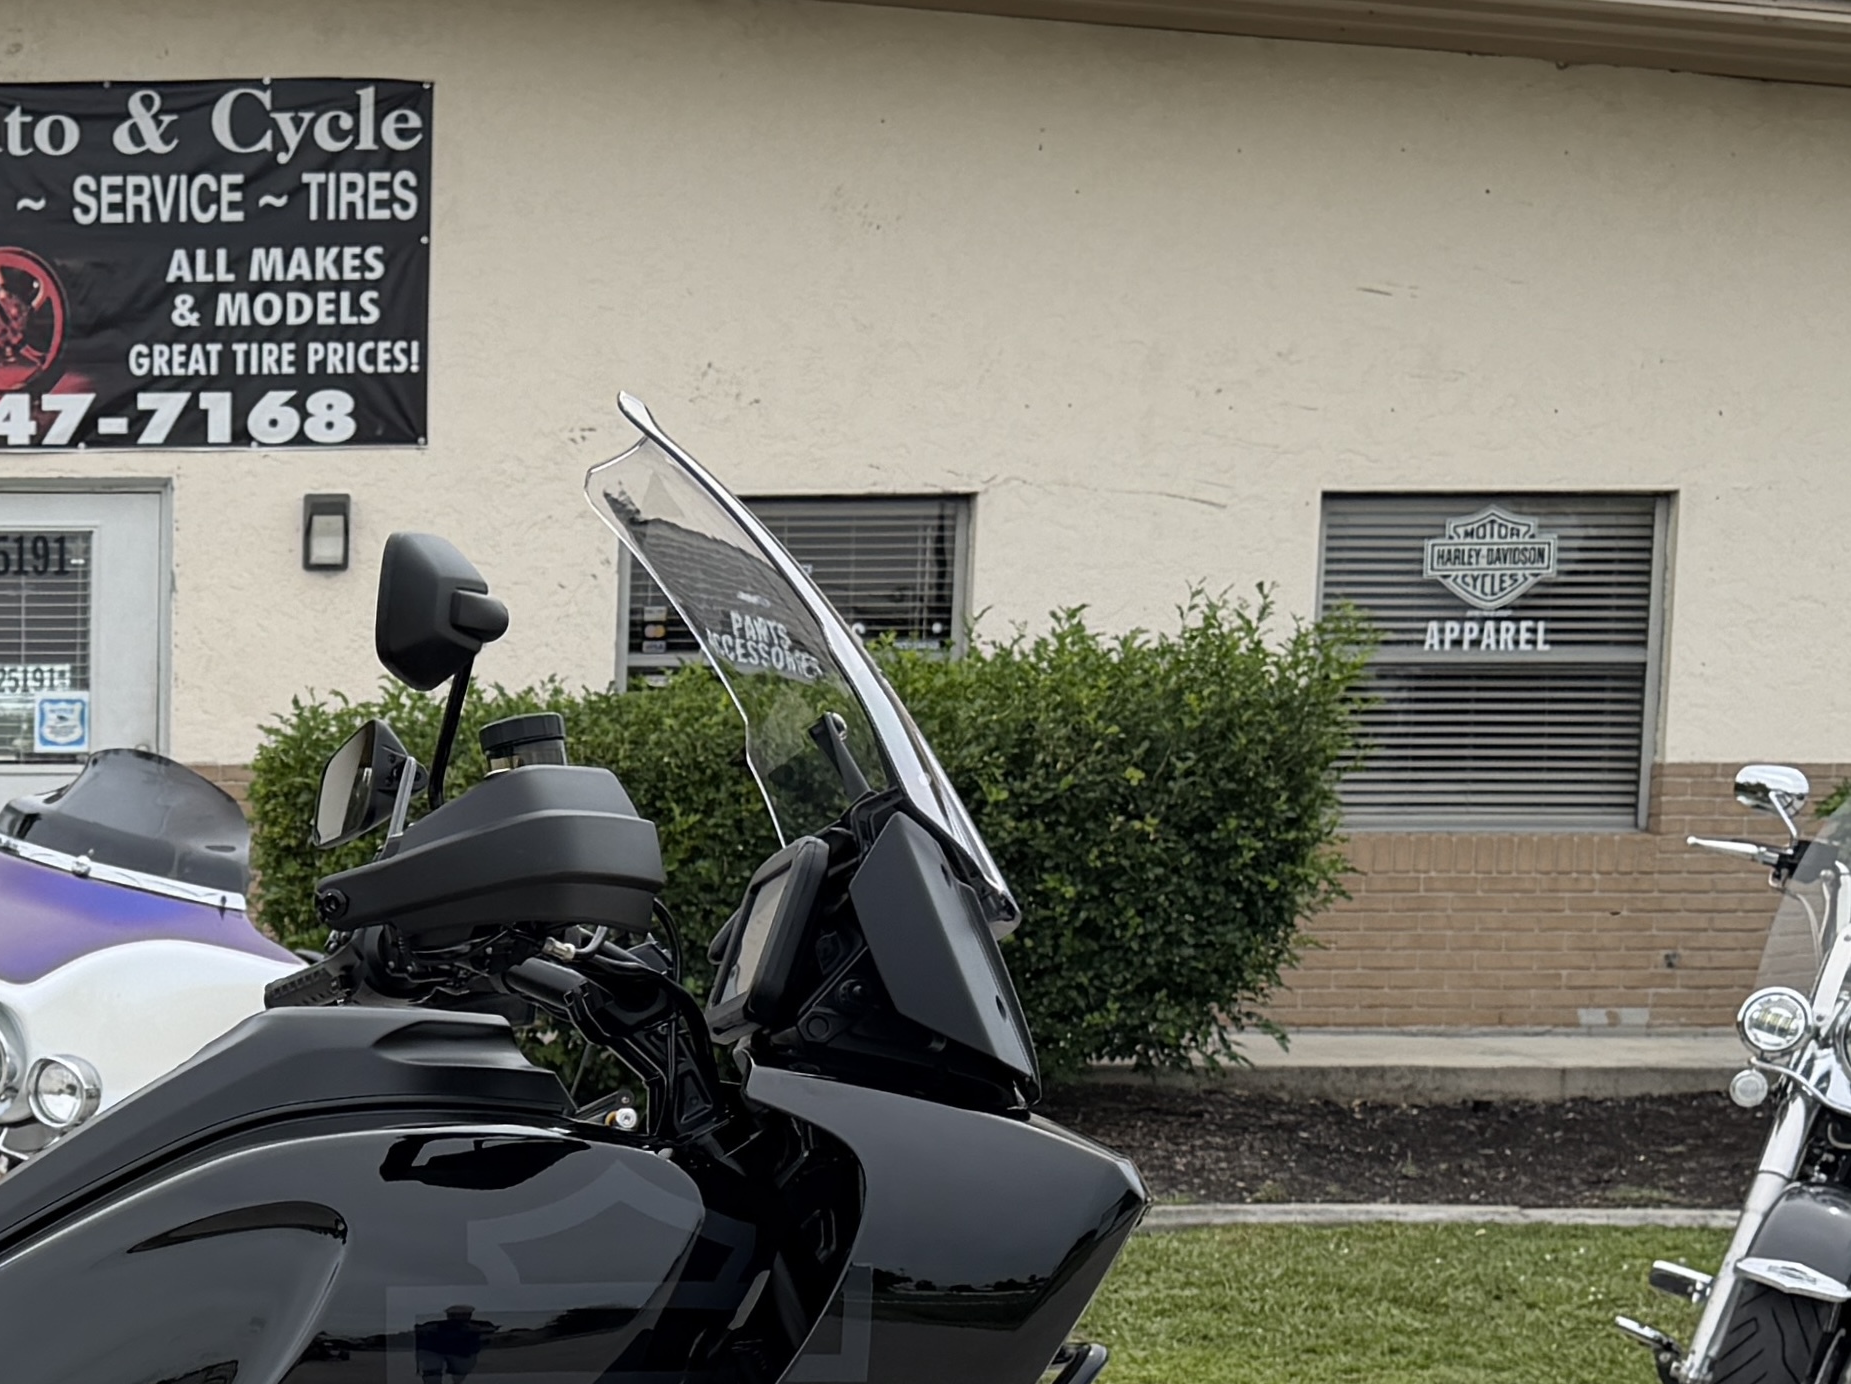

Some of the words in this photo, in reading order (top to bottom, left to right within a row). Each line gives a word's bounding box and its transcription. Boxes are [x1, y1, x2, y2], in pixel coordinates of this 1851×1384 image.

[112, 89, 179, 156] &
[210, 85, 423, 165] Cycle
[71, 172, 245, 226] SERVICE
[300, 169, 419, 222] TIRES
[164, 247, 237, 284] ALL
[248, 244, 386, 283] MAKES
[170, 292, 201, 328] &
[214, 289, 381, 327] MODELS
[127, 342, 224, 377] GREAT
[230, 341, 297, 376] TIRE
[306, 339, 421, 375] PRICES!
[1462, 519, 1521, 540] MOTOR
[1436, 546, 1546, 566] HARLEY-DAVIDSON
[1460, 573, 1520, 597] CYCLES
[1423, 620, 1552, 652] APPAREL
